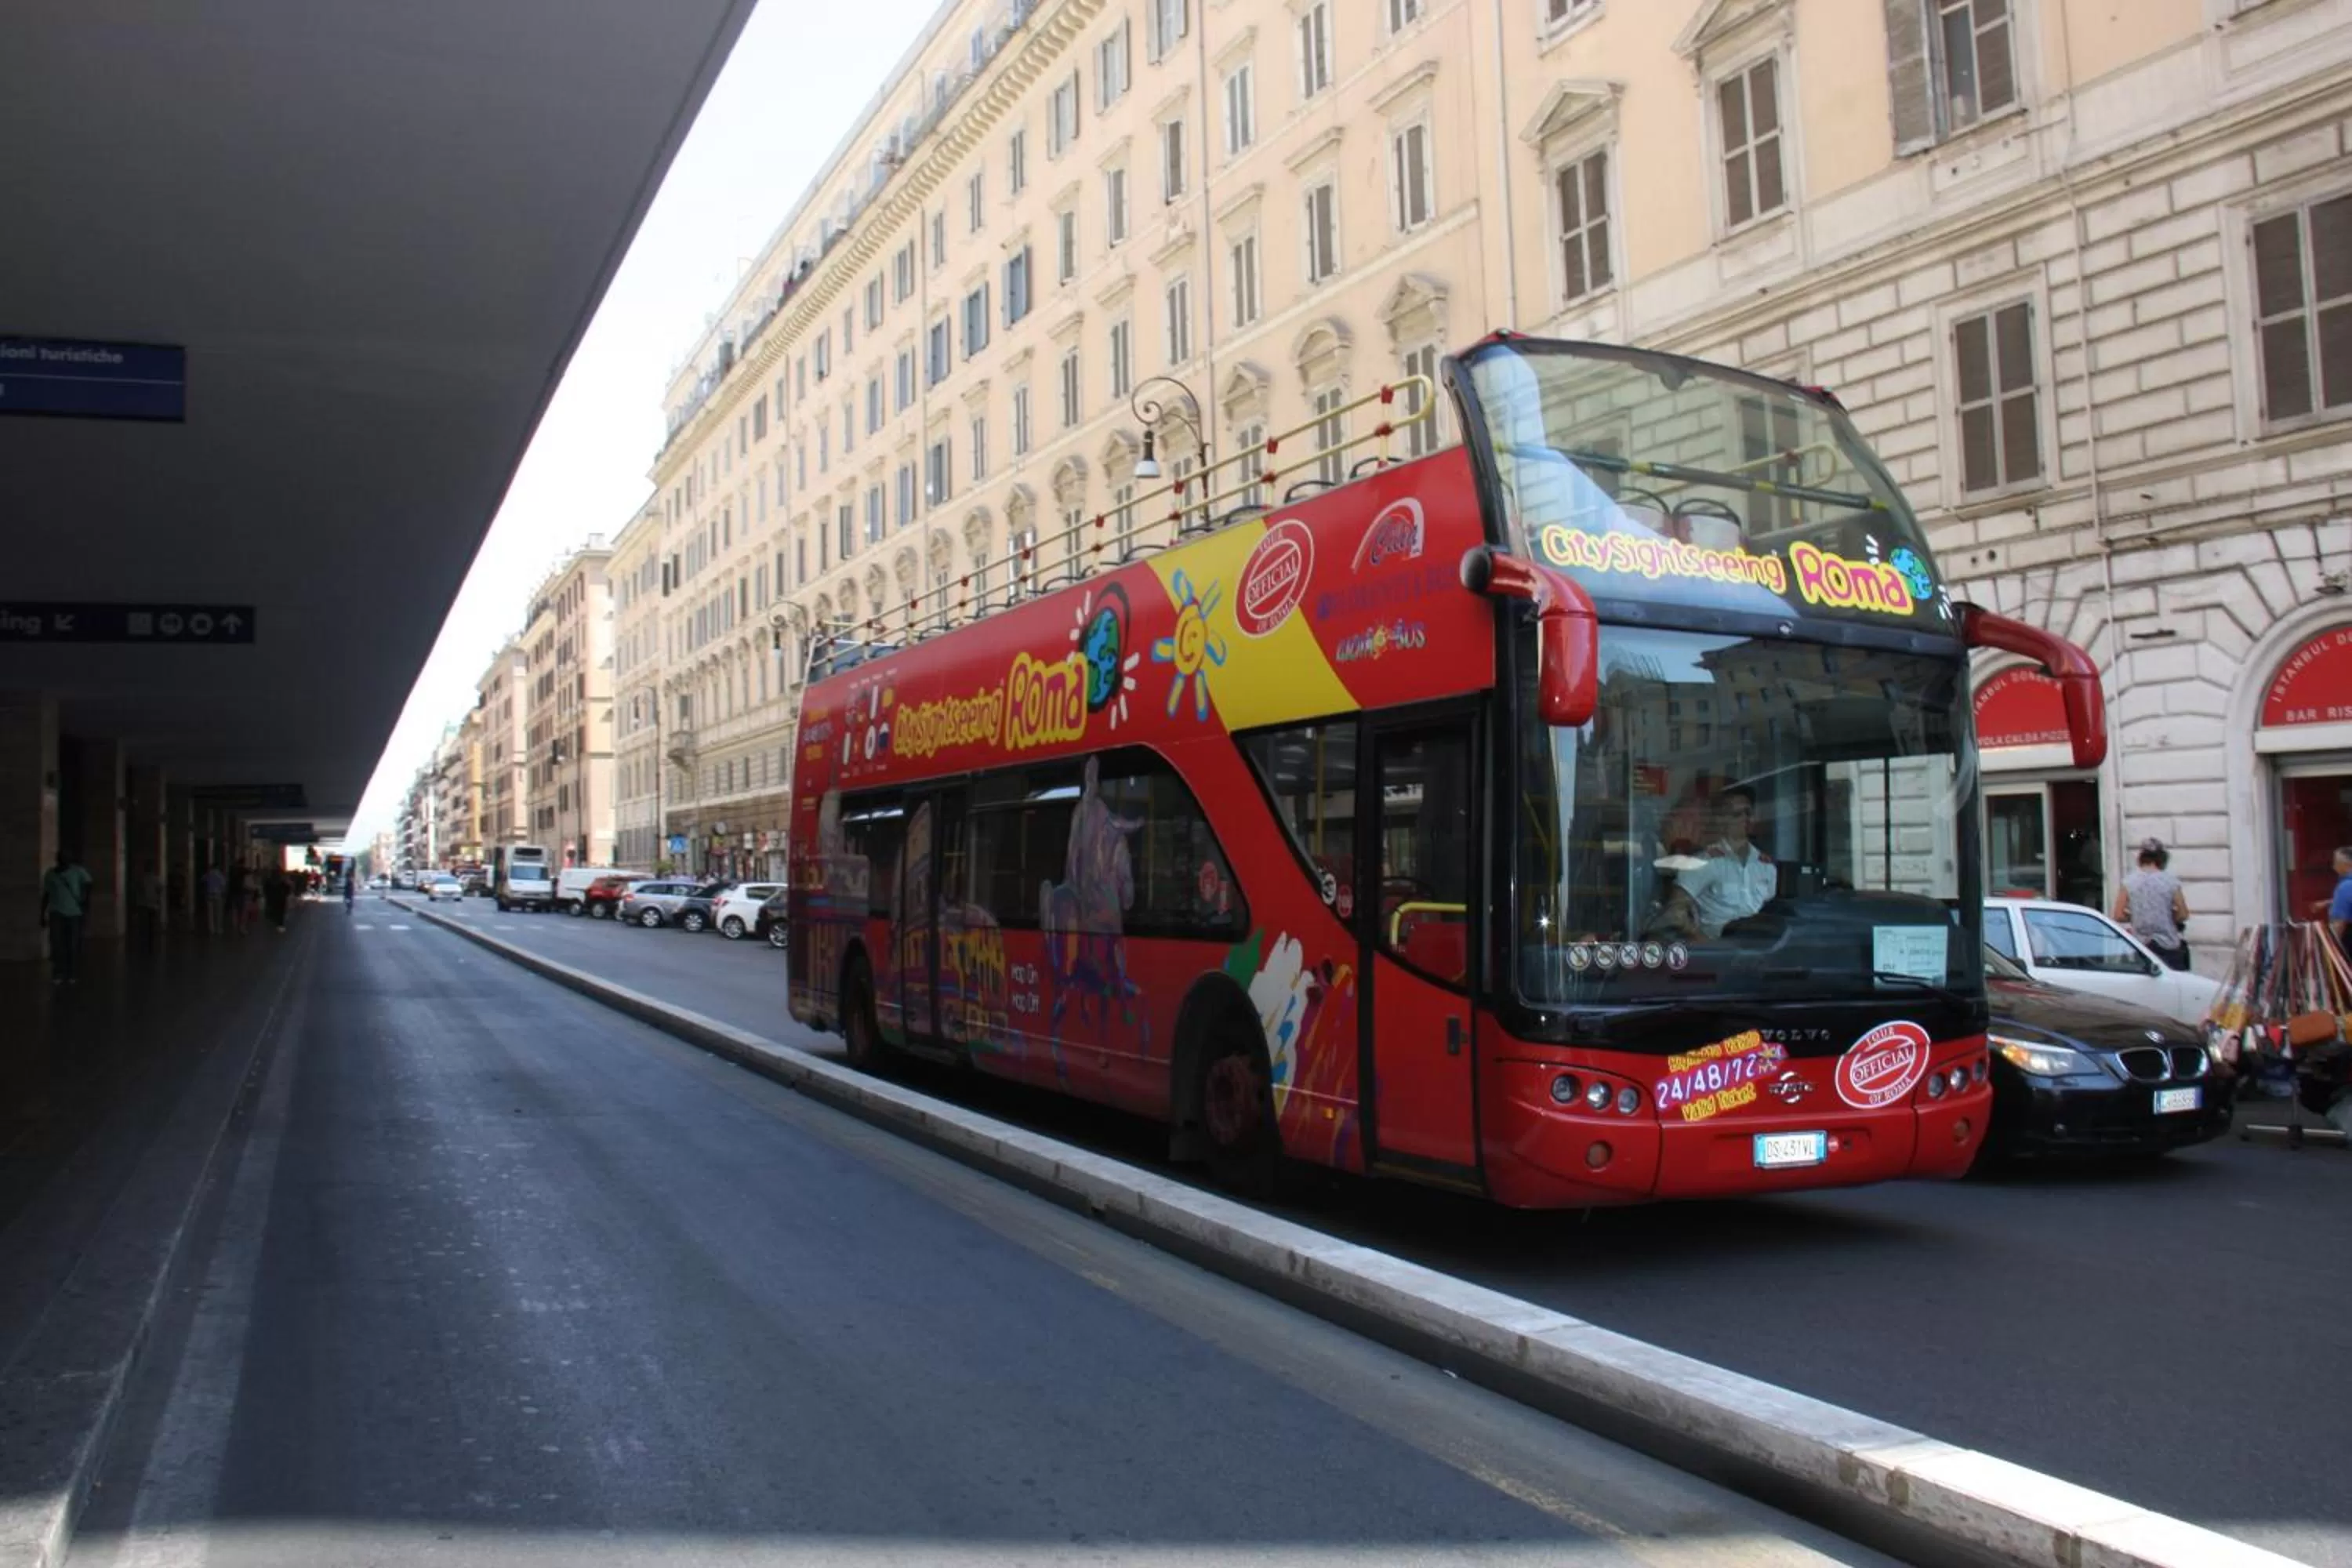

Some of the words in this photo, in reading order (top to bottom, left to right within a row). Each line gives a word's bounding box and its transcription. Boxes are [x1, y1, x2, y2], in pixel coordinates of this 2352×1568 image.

[40, 345, 125, 365] turistiche
[1247, 553, 1298, 604] OFFICIAL
[2270, 638, 2330, 702] ISTANBUL
[2285, 707, 2317, 722] BAR
[1761, 1028, 1831, 1041] VOLVO
[1866, 1026, 1895, 1047] TOUR
[1853, 1045, 1911, 1082] OFFICIAL
[1867, 1092, 1882, 1105] OF
[1884, 1075, 1913, 1100] ROMA
